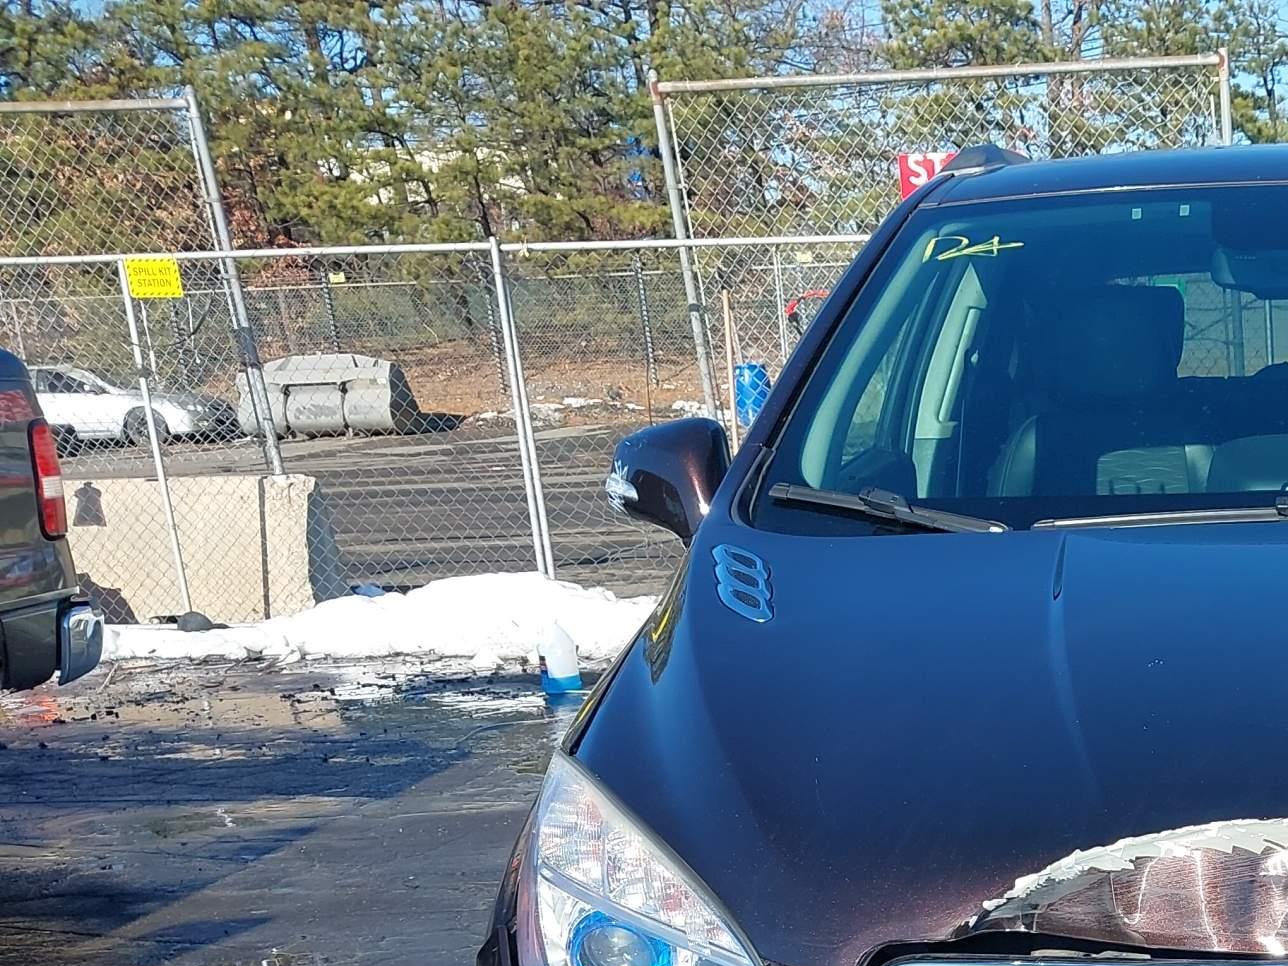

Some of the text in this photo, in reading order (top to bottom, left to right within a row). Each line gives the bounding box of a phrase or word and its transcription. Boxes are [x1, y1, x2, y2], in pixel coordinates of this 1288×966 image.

[907, 153, 950, 187] ST
[132, 266, 171, 276] SPILL KIT
[137, 278, 172, 288] STATION
